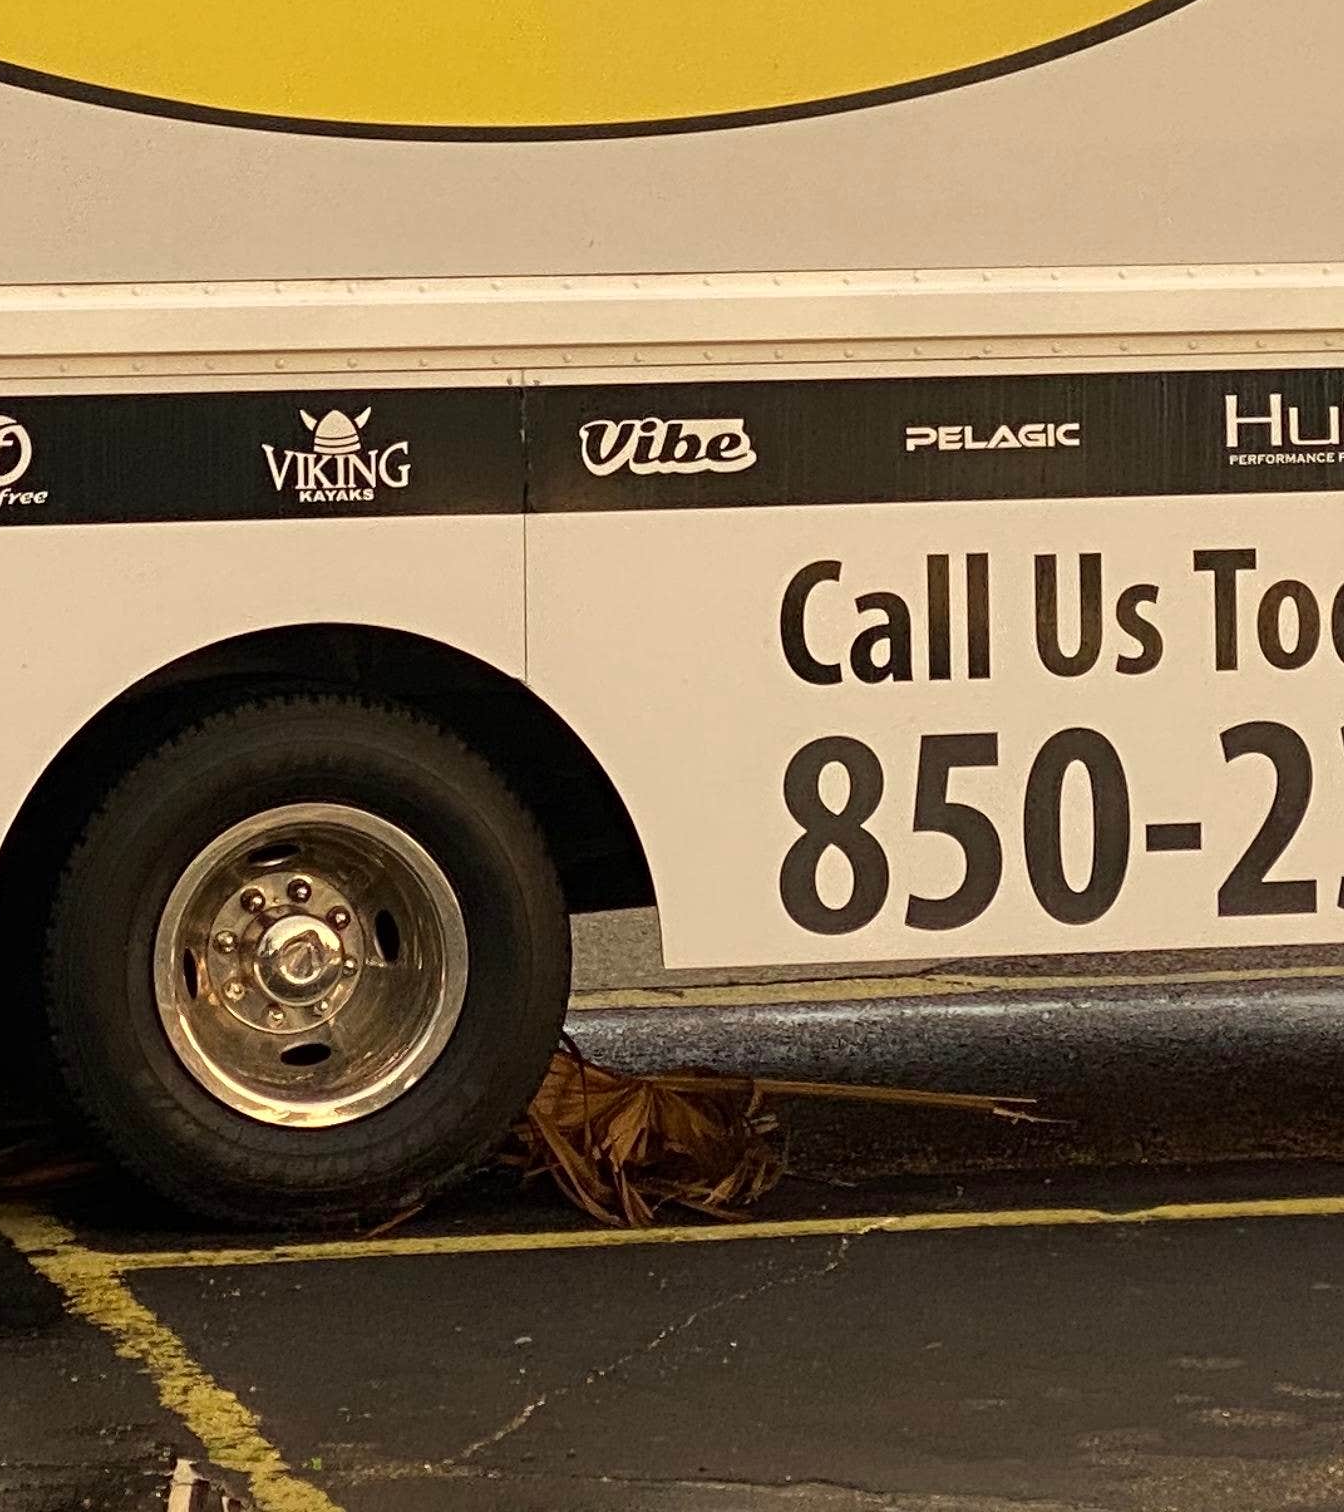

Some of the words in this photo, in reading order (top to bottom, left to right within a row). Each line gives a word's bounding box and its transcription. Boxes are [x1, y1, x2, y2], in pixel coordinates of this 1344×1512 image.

[581, 419, 750, 468] Vibe
[905, 423, 1081, 452] PELAGIC
[261, 441, 412, 491] VIKING
[1229, 452, 1335, 465] PERFORMANCE
[299, 488, 375, 503] KAYAKS
[779, 551, 992, 686] Call
[1031, 551, 1163, 678] Us
